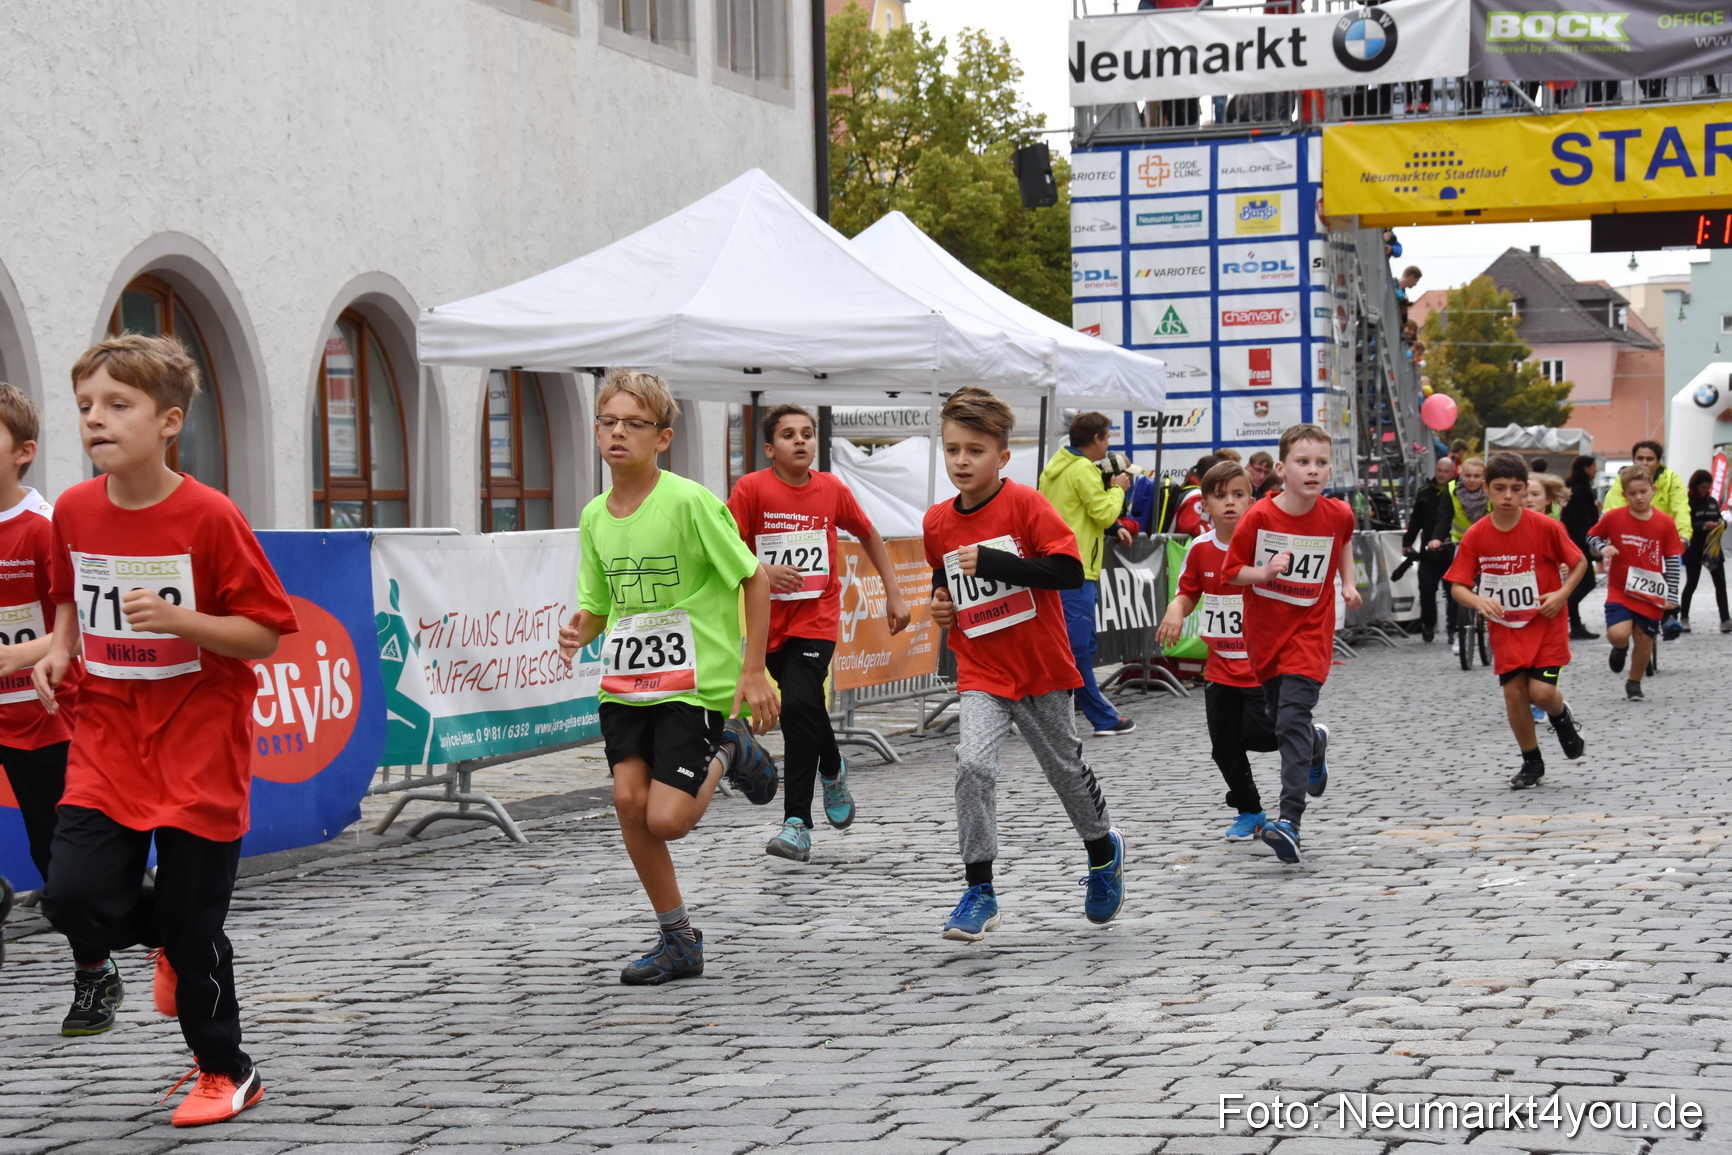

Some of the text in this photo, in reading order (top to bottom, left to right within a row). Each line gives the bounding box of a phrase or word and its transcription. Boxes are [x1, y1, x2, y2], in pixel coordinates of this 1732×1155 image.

[1657, 10, 1725, 29] OFFICE
[1488, 13, 1627, 40] BOCK
[1530, 44, 1543, 54] by
[1173, 160, 1198, 170] CODE
[1174, 169, 1203, 179] CLINIC
[1359, 165, 1508, 184] Neumarkter Stadtlauf
[1138, 214, 1175, 224] Neumarkter
[1153, 265, 1206, 278] VARIOTEC
[1260, 270, 1295, 280] energie
[1084, 279, 1118, 289] energie
[1224, 310, 1278, 323] charivari
[1243, 420, 1281, 428] Neumarkter
[763, 511, 810, 521] Neumarkter
[763, 521, 801, 532] Stadtlauf
[1293, 538, 1327, 548] BOCK
[116, 561, 180, 575] BOCK
[1266, 580, 1315, 597] Alexander
[1631, 576, 1665, 596] 7230
[967, 602, 1011, 625] Lennart
[635, 613, 682, 628] BOCK
[461, 610, 501, 648] UNS
[106, 643, 158, 663] Niklas
[611, 632, 687, 671] 7233
[633, 677, 661, 690] Paul
[508, 722, 530, 739] 6352
[256, 732, 304, 757] ORTS
